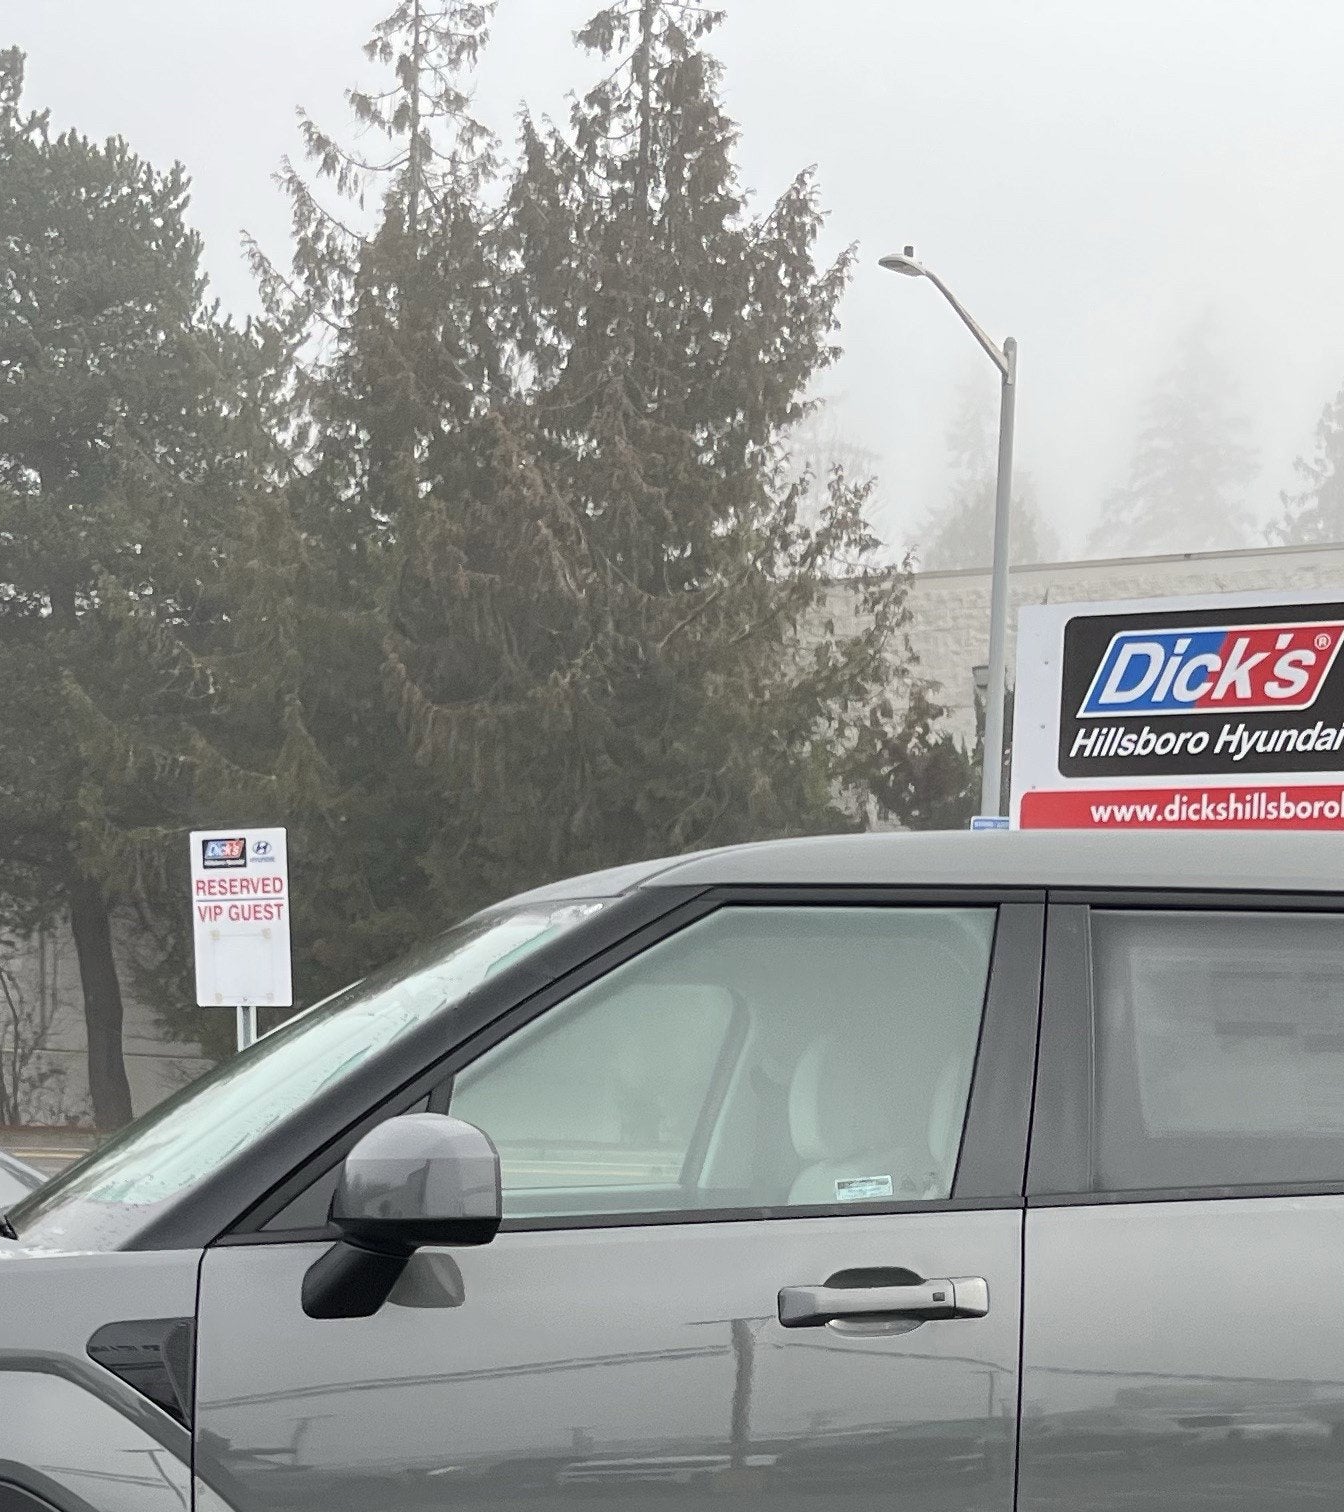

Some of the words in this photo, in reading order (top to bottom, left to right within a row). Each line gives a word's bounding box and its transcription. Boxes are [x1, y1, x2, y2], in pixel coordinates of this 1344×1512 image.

[1098, 633, 1317, 705] Dick's
[1069, 726, 1209, 758] Hillsboro
[195, 877, 284, 896] RESERVED
[198, 905, 223, 923] VIP
[228, 903, 284, 922] GUEST
